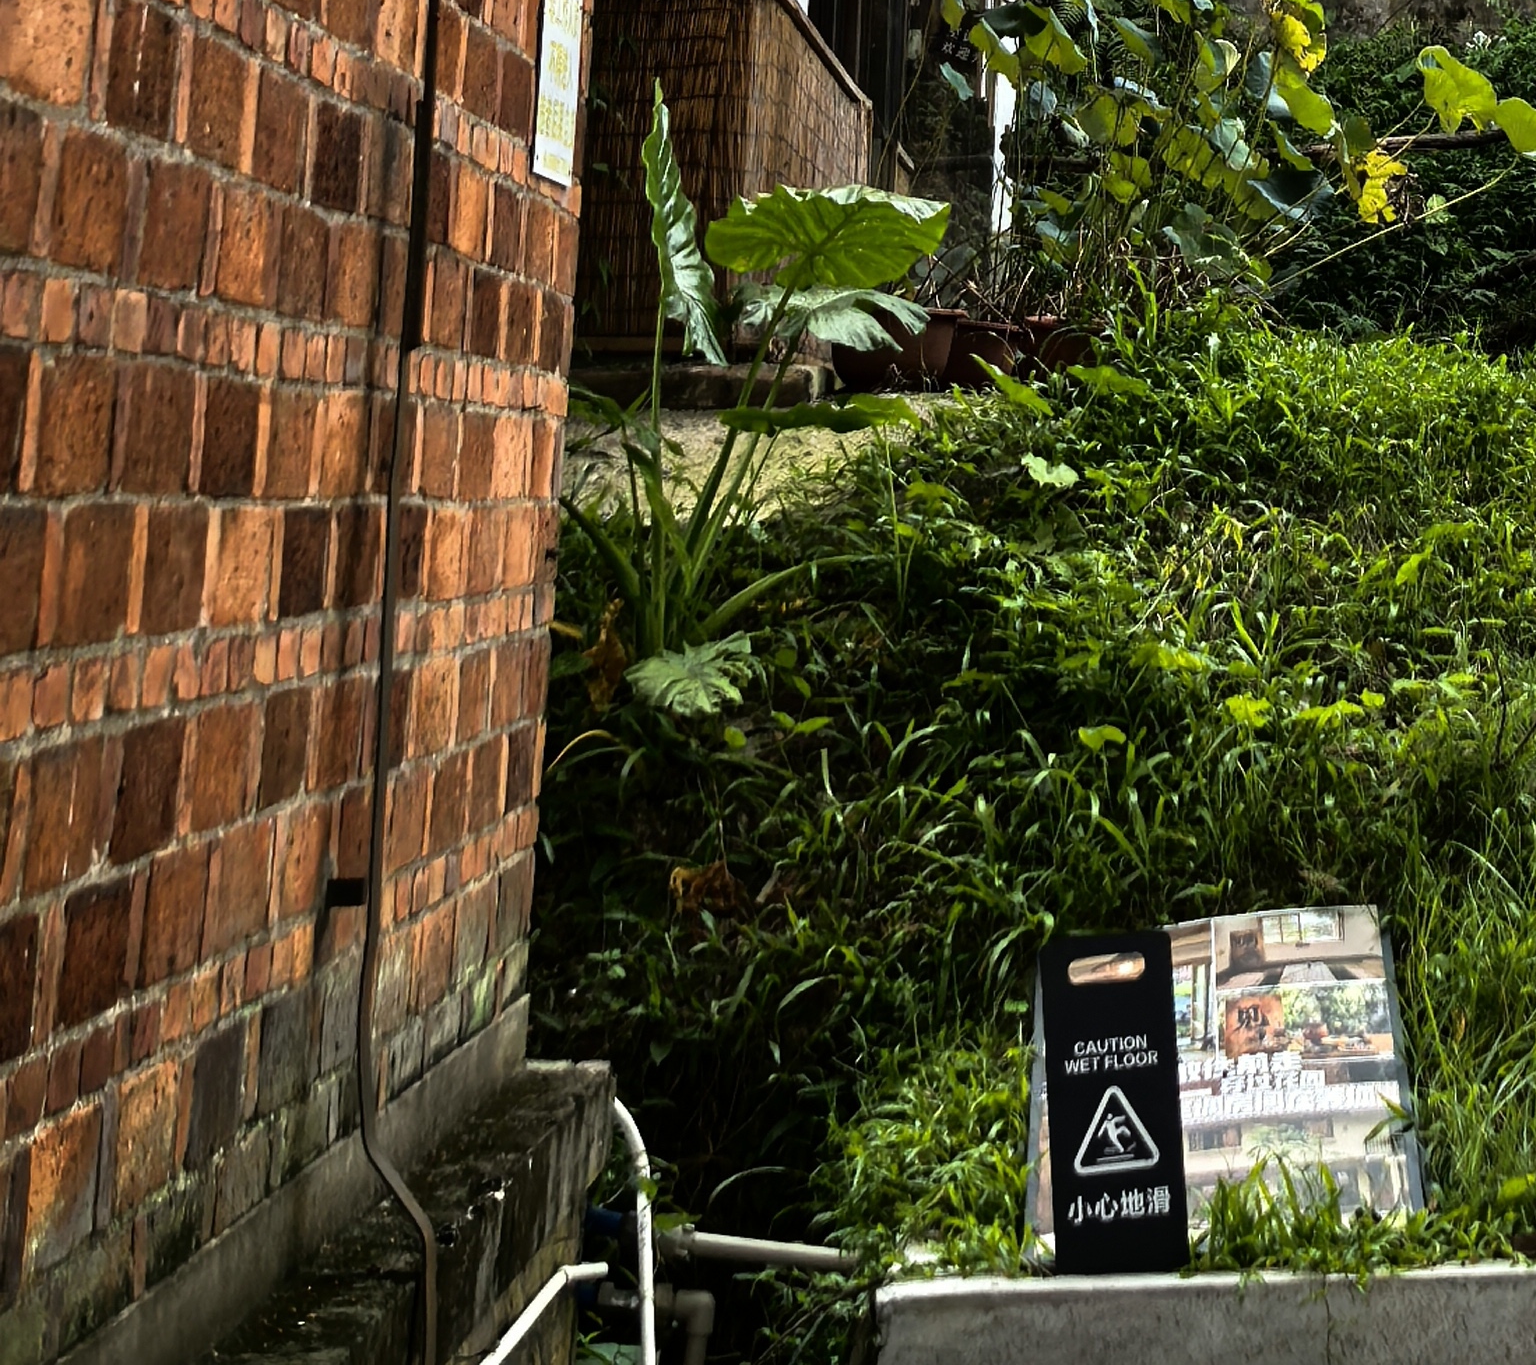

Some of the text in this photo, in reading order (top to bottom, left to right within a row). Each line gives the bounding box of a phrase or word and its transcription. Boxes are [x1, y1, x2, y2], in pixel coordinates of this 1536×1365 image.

[1074, 1034, 1148, 1056] CAUTION
[1064, 1050, 1158, 1075] WET FLOOR
[1068, 1185, 1171, 1225] 小心地滑
